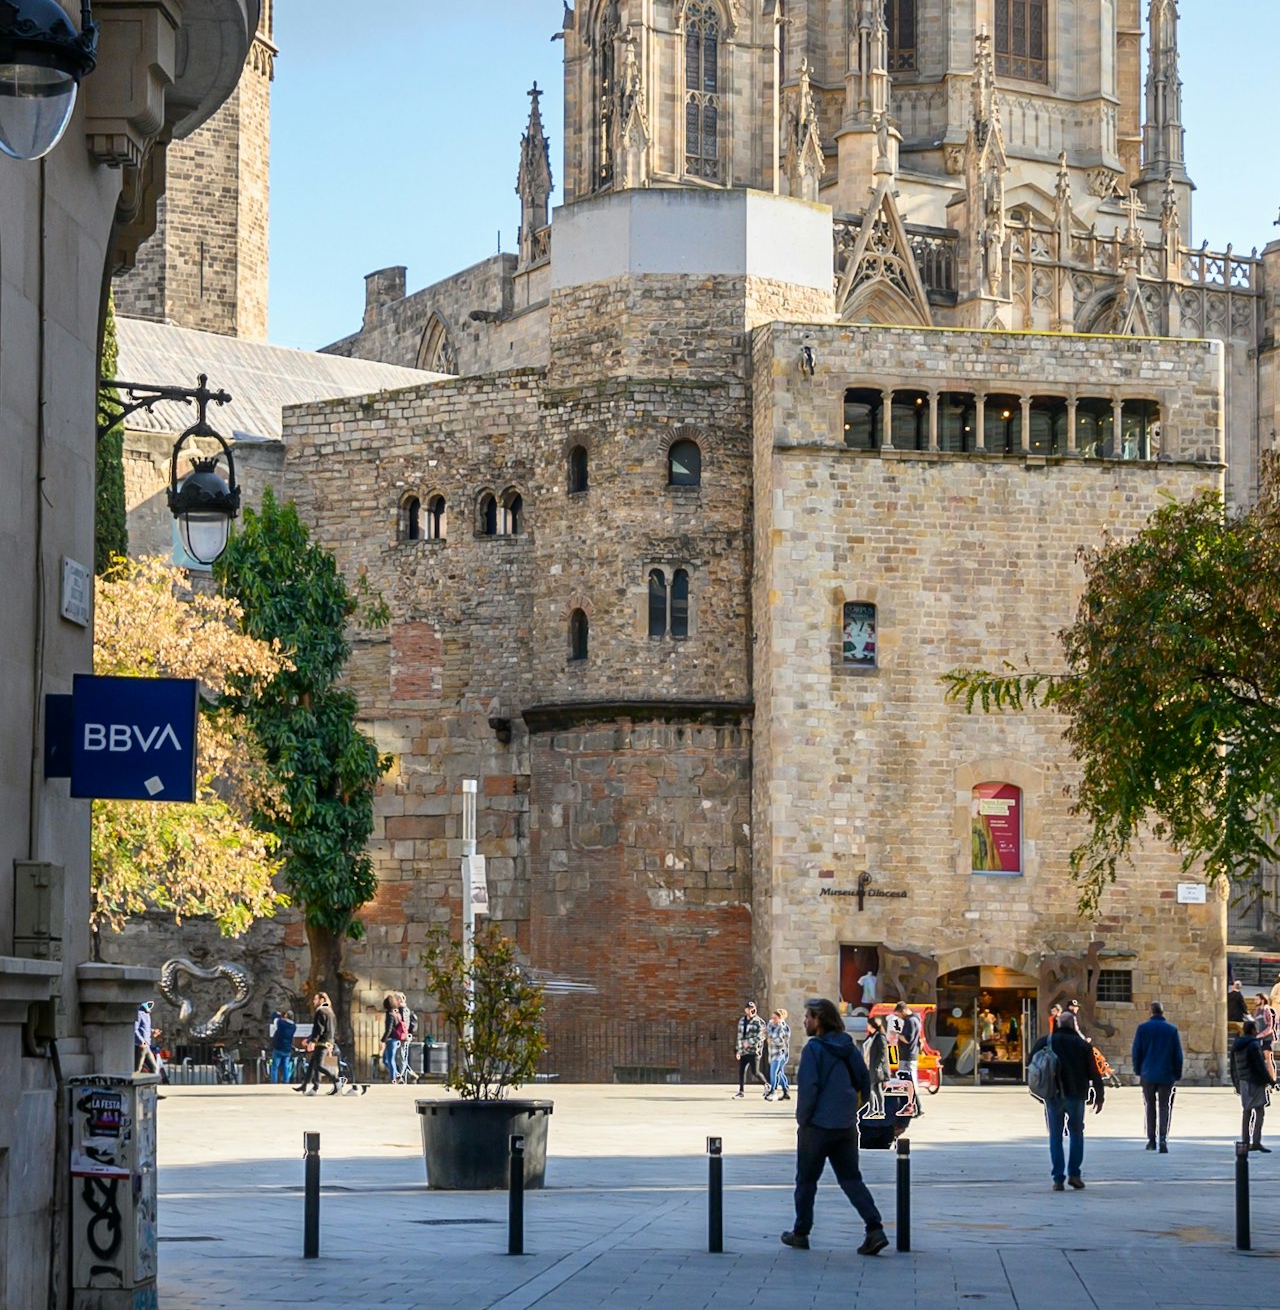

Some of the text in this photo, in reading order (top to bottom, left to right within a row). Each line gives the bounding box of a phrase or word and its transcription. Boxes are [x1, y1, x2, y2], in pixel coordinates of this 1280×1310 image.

[84, 723, 182, 752] BBVA
[92, 1099, 120, 1109] LA FESTA
